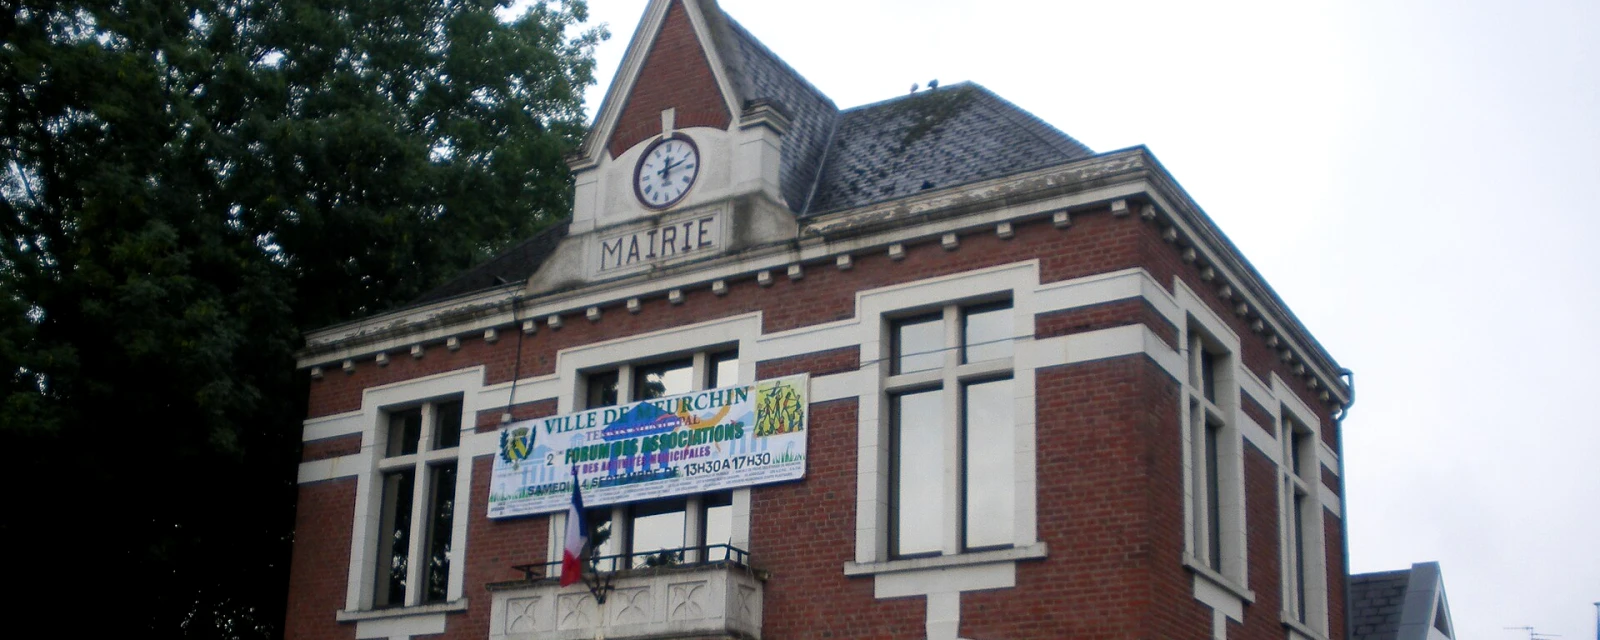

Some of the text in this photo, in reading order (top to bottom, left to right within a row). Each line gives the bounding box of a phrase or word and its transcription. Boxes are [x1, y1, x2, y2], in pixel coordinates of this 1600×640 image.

[601, 217, 713, 270] MAIRIE
[545, 386, 750, 435] VILLE DE MEURCHIN
[565, 442, 610, 464] FORUM
[611, 437, 639, 457] DES
[641, 421, 744, 451] ASSOCIATIONS
[583, 462, 599, 474] DES
[650, 446, 711, 465] MUNICIPALES
[527, 481, 570, 496] SAMEDI
[684, 460, 721, 476] 13H30
[731, 452, 771, 470] 17H30
